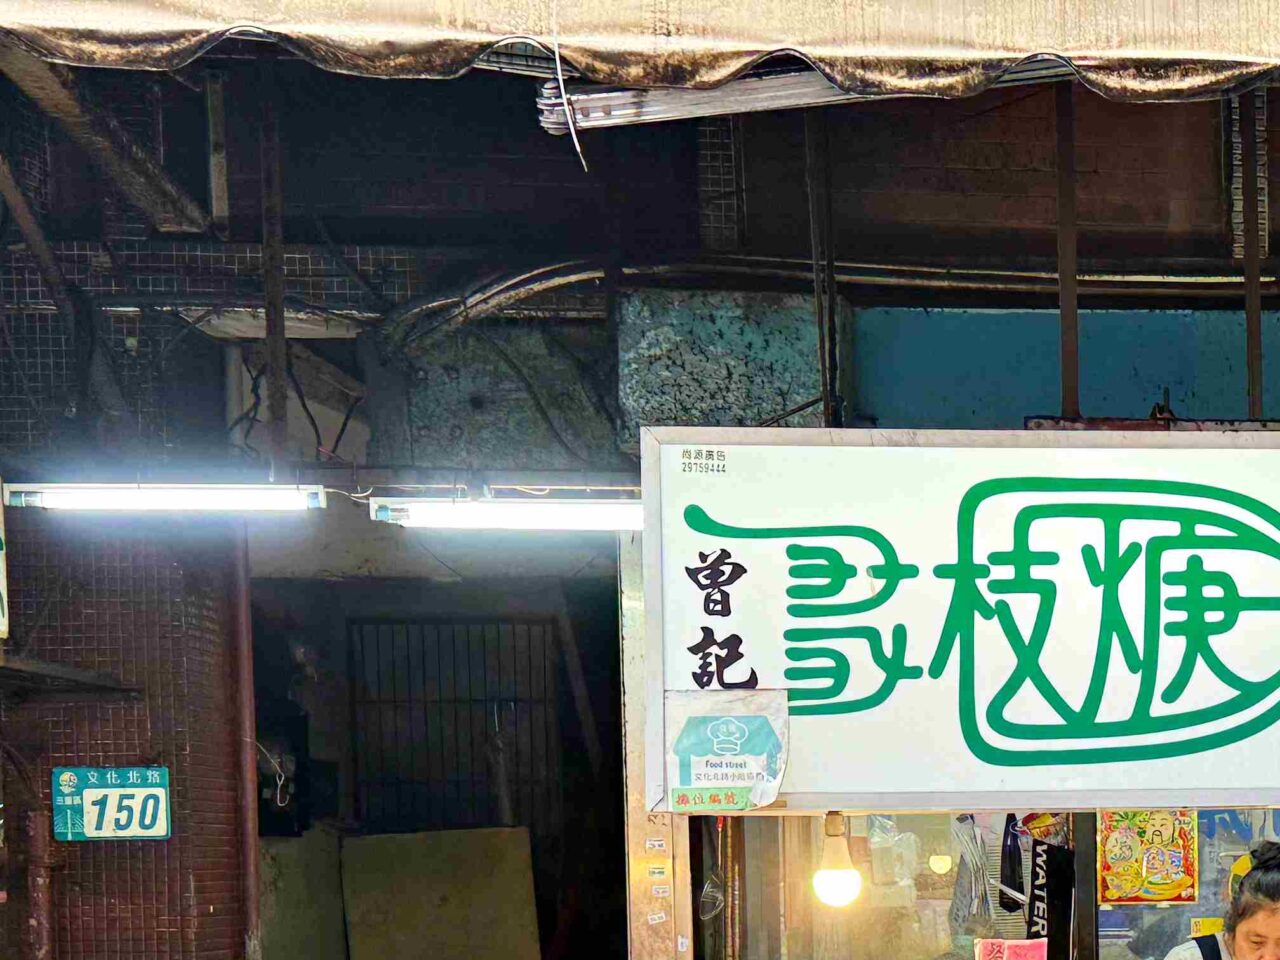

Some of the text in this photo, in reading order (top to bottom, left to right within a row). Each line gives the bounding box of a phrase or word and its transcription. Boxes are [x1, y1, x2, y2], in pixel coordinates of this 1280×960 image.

[684, 548, 759, 690] 曾記
[87, 770, 160, 785] 文化北路
[705, 760, 723, 769] Food
[91, 793, 161, 831] 150
[1030, 844, 1048, 939] WATER
